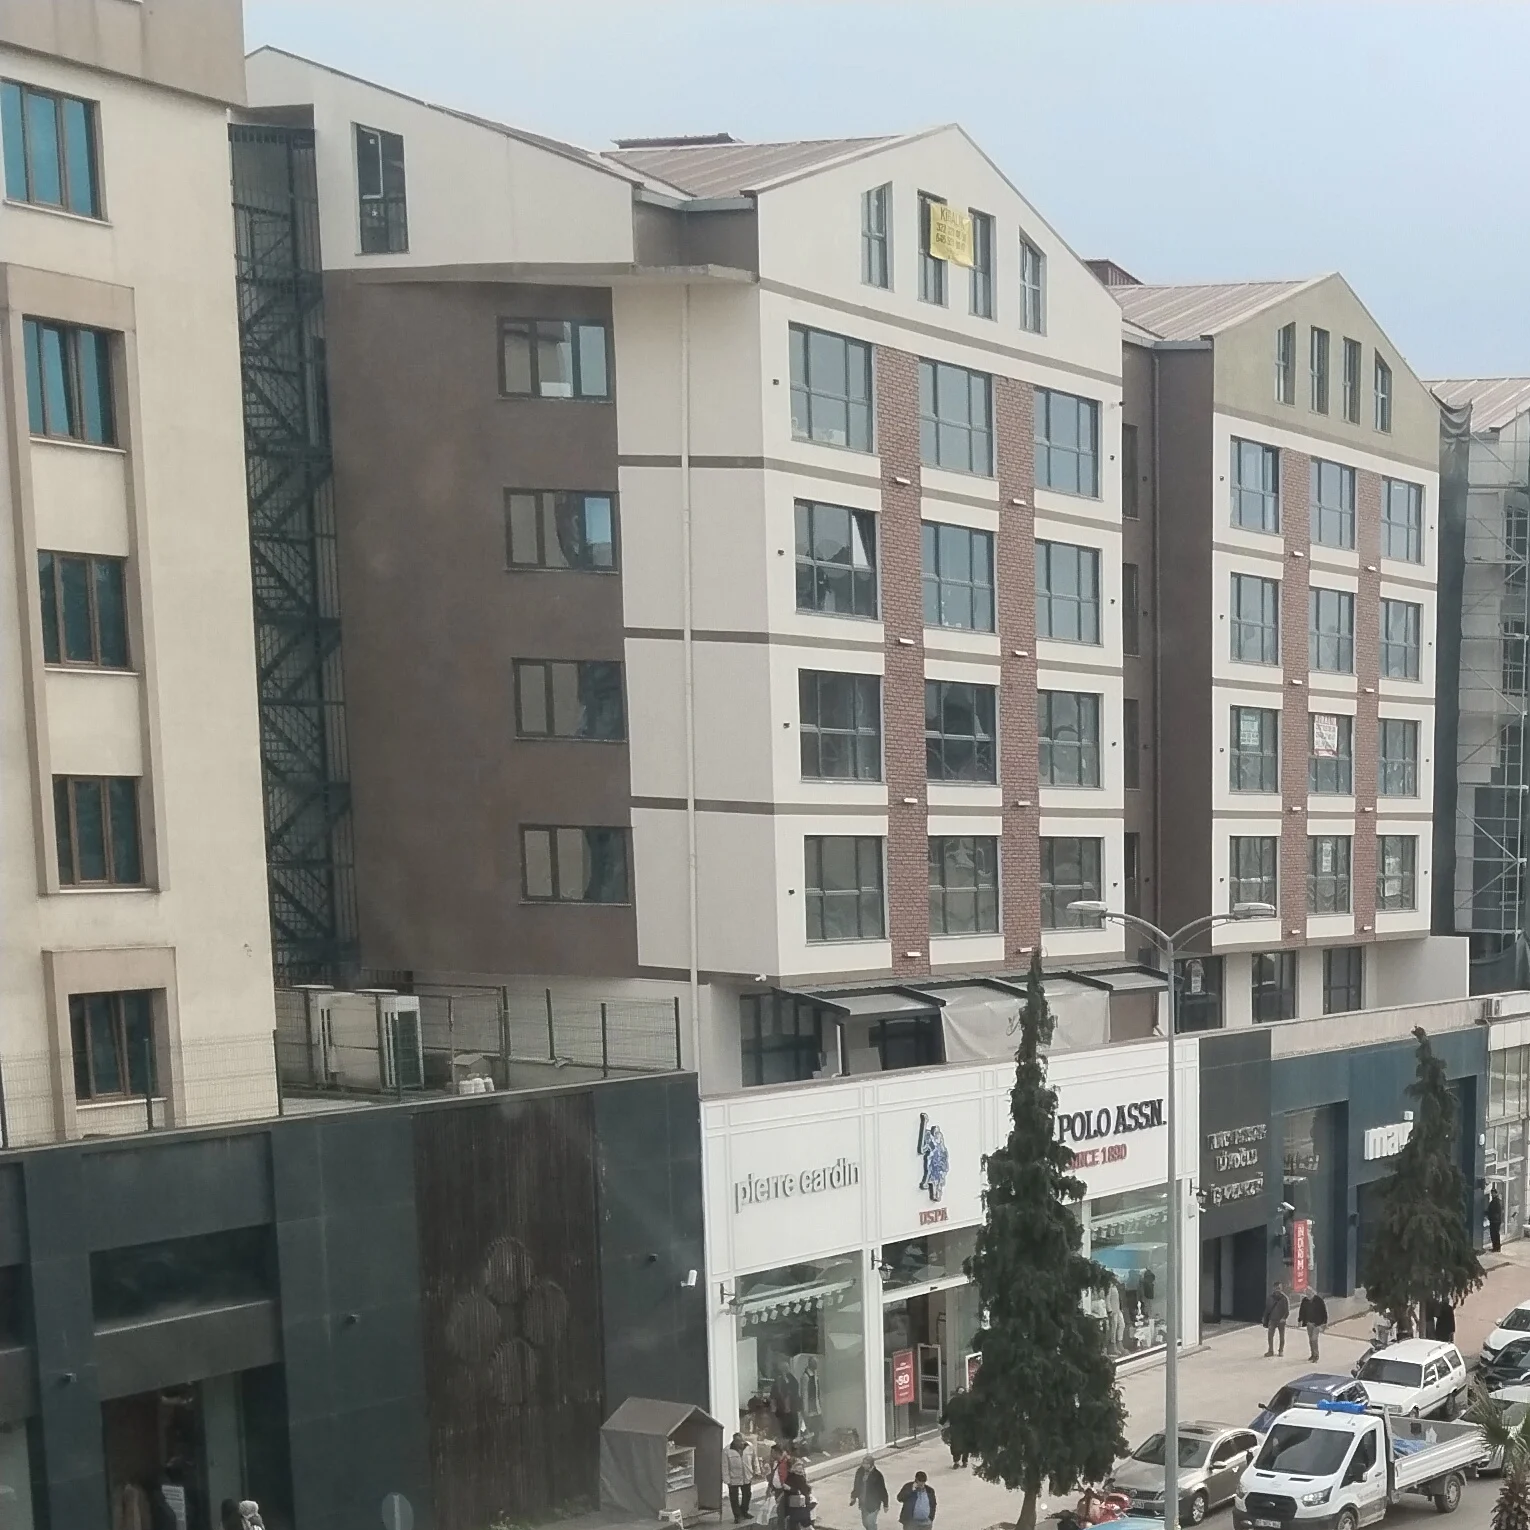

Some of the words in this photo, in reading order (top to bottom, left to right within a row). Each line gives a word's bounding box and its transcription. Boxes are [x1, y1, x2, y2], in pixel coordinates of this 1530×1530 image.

[1057, 1107, 1112, 1144] POLO
[1113, 1099, 1167, 1135] ASSN.
[1101, 1143, 1127, 1164] 1890
[735, 1173, 797, 1214] pierre
[800, 1158, 860, 1194] cardin
[919, 1207, 949, 1226] USPA
